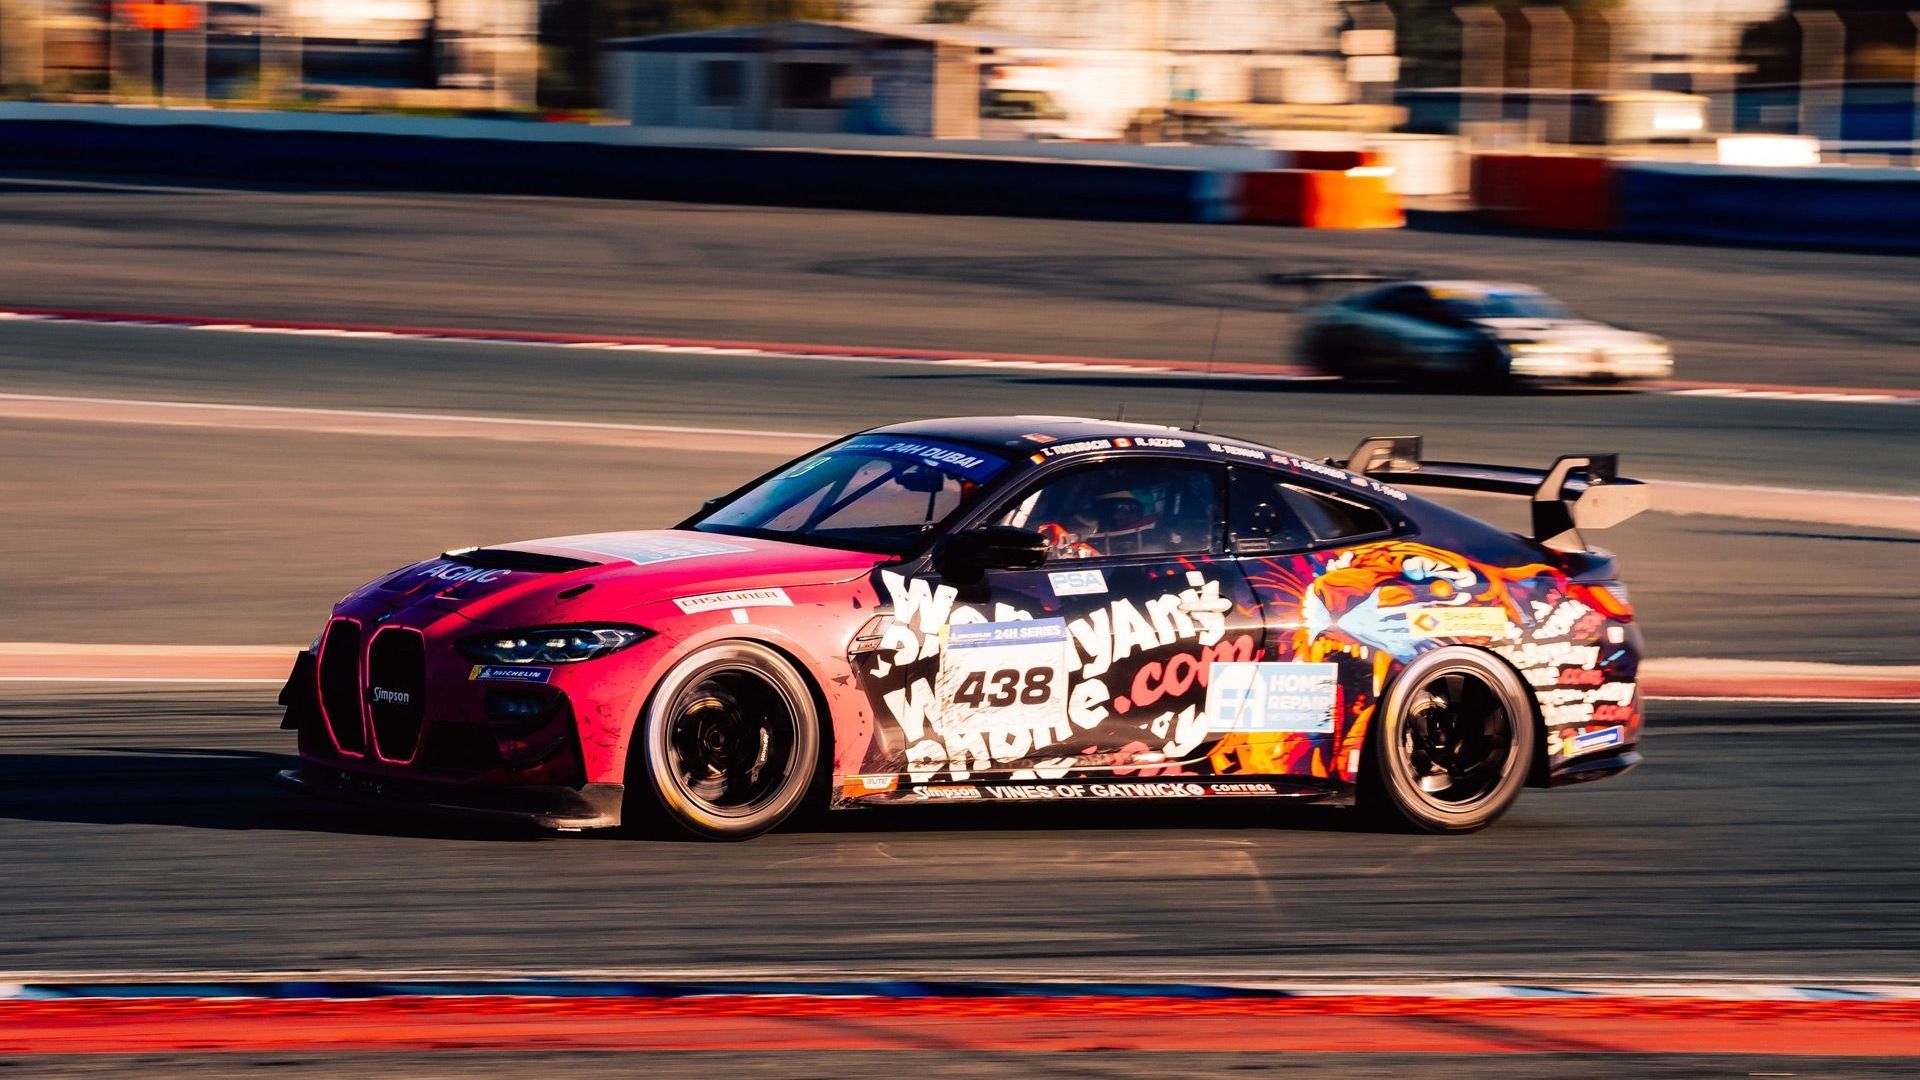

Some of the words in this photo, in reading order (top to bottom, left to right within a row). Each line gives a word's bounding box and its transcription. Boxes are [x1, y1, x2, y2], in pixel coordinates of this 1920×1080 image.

[884, 442, 921, 456] 24H
[921, 447, 985, 469] DUBAI
[1052, 572, 1104, 589] PSA
[994, 627, 1018, 640] 24H
[1020, 624, 1061, 638] SERIES
[492, 669, 542, 678] MICHELIN
[953, 666, 1054, 709] 438
[1270, 675, 1331, 692] HOME
[373, 686, 411, 704] Simpson
[912, 784, 981, 801] Simpson
[986, 784, 1053, 800] VINES
[1055, 784, 1087, 798] OF
[1089, 782, 1189, 798] GATWICK
[1210, 783, 1276, 793] CONTROL
